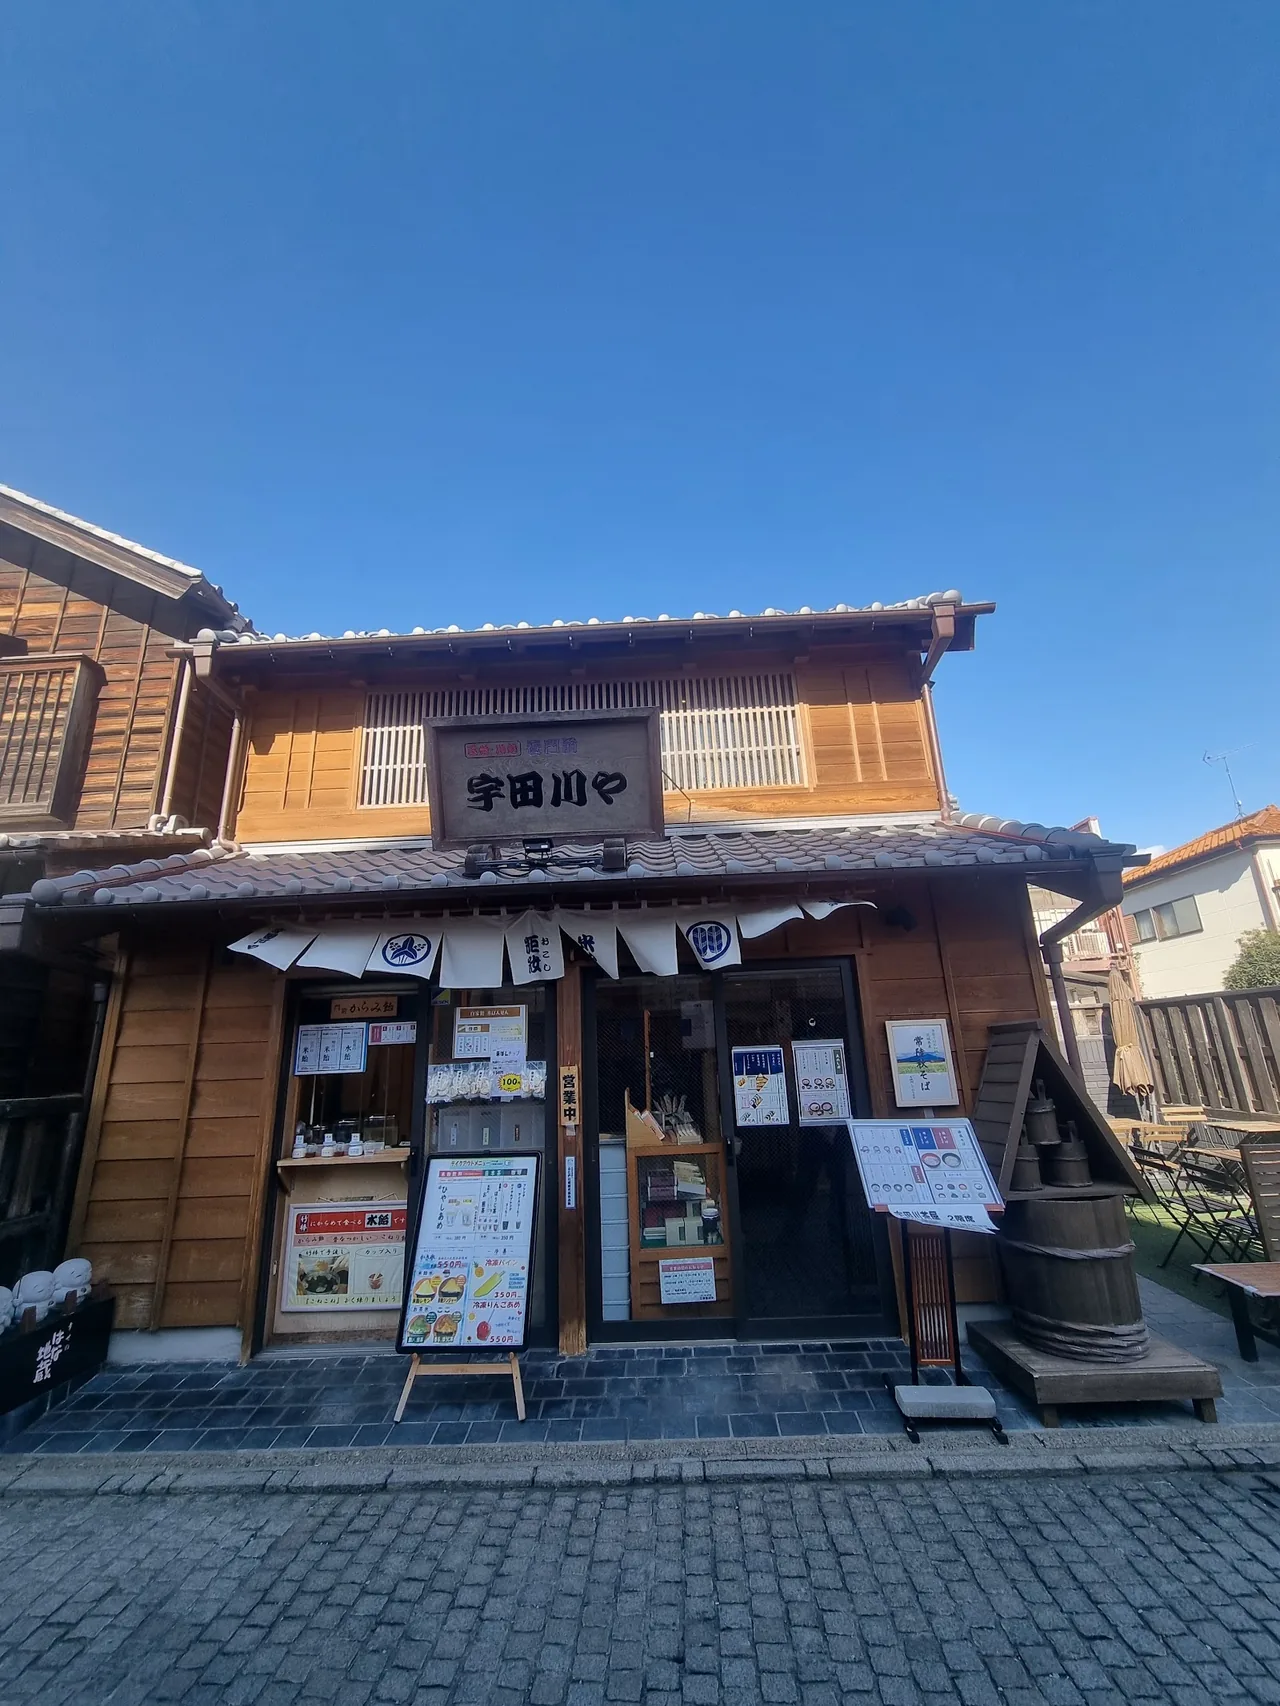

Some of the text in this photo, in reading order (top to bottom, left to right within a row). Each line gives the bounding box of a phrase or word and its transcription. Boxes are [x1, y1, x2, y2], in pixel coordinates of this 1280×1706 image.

[466, 768, 628, 813] 宇田川や
[541, 937, 551, 972] おこし
[349, 1001, 395, 1013] からみ飴
[562, 1073, 577, 1122] 営業中
[436, 1185, 448, 1230] ひやしあめ
[310, 1218, 362, 1227] にからめて食べる
[366, 1213, 389, 1226] 水飴
[437, 1260, 462, 1269] 550円
[485, 1259, 518, 1267] 冷凍パイン
[472, 1301, 521, 1309] 冷凍りんごあめ
[51, 1329, 65, 1362] はな
[490, 1335, 514, 1343] 550円
[33, 1340, 52, 1384] 地蔵
